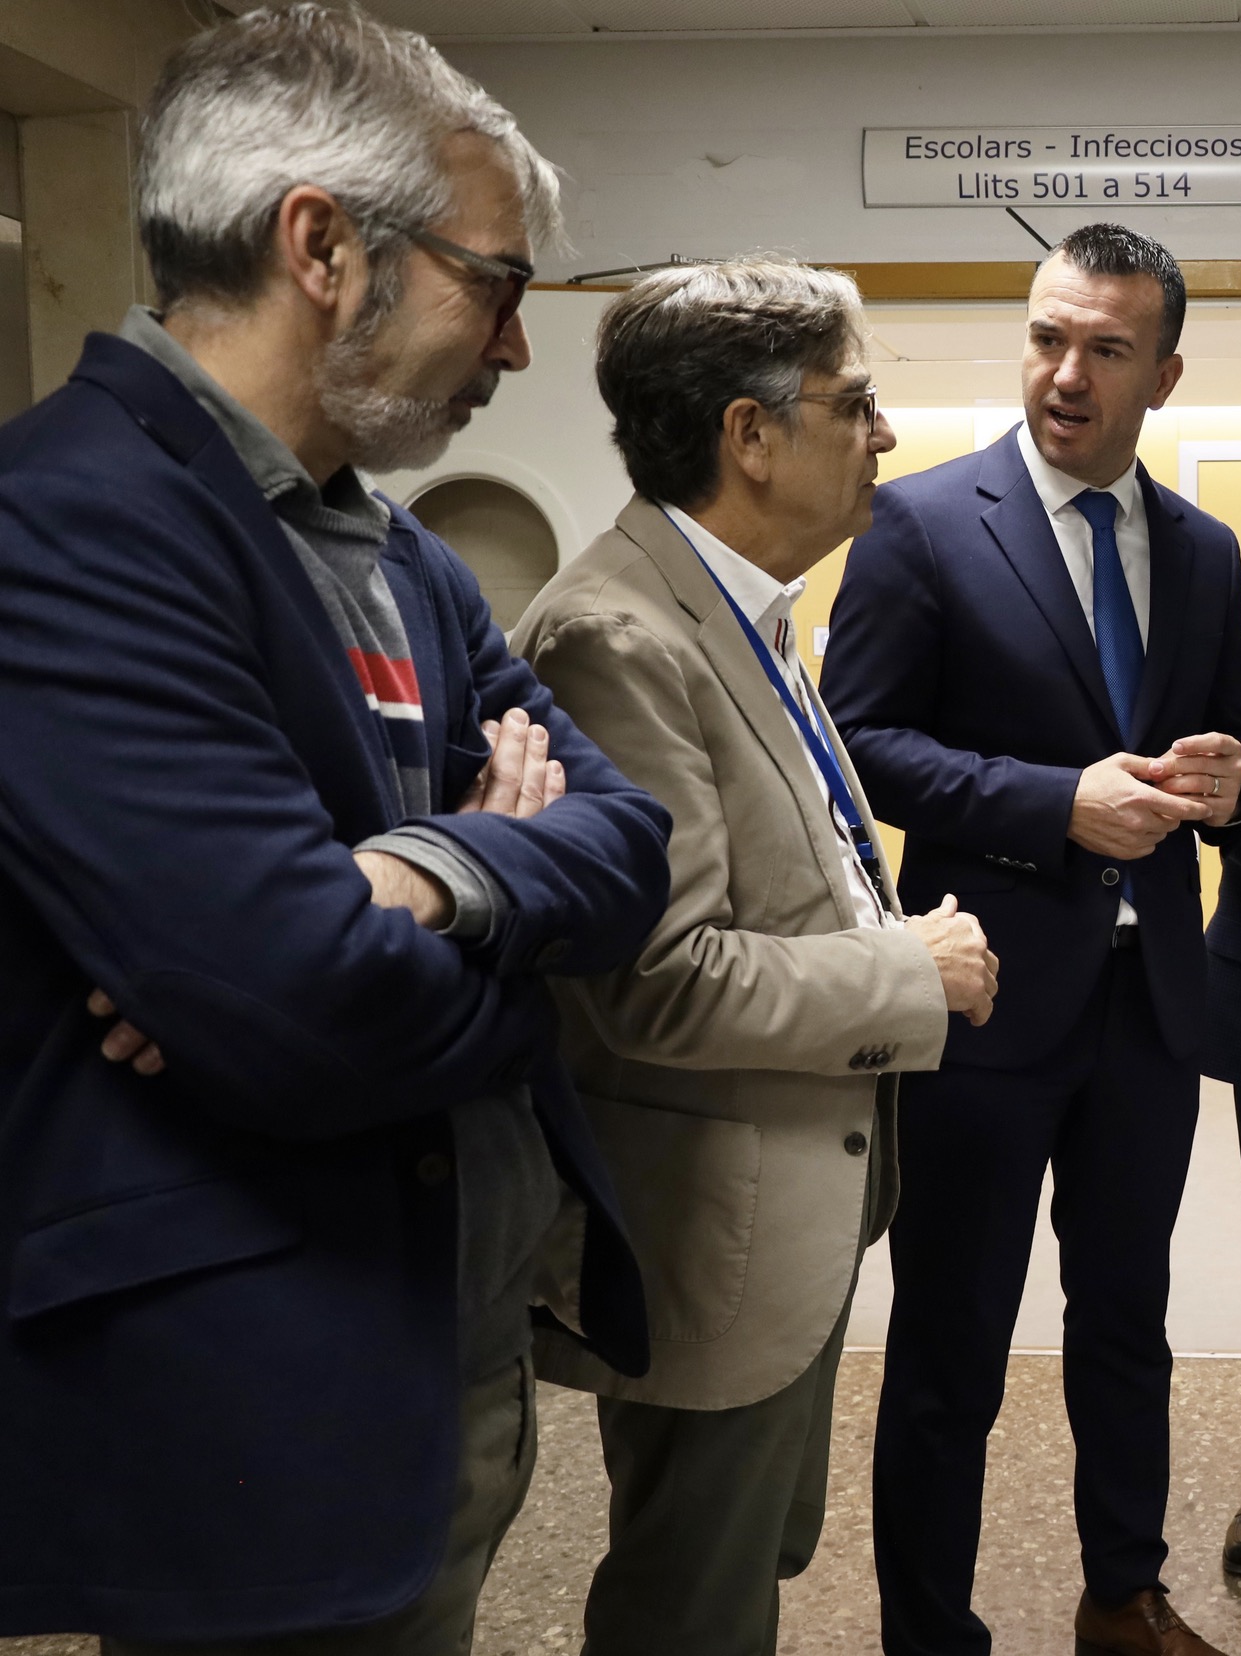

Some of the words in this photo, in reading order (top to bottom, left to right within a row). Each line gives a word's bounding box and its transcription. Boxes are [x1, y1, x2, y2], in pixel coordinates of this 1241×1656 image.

[904, 134, 1032, 160] Escolars
[957, 172, 1020, 200] Llits
[1032, 172, 1089, 199] 501
[1103, 178, 1120, 198] a
[1133, 172, 1192, 198] 514
